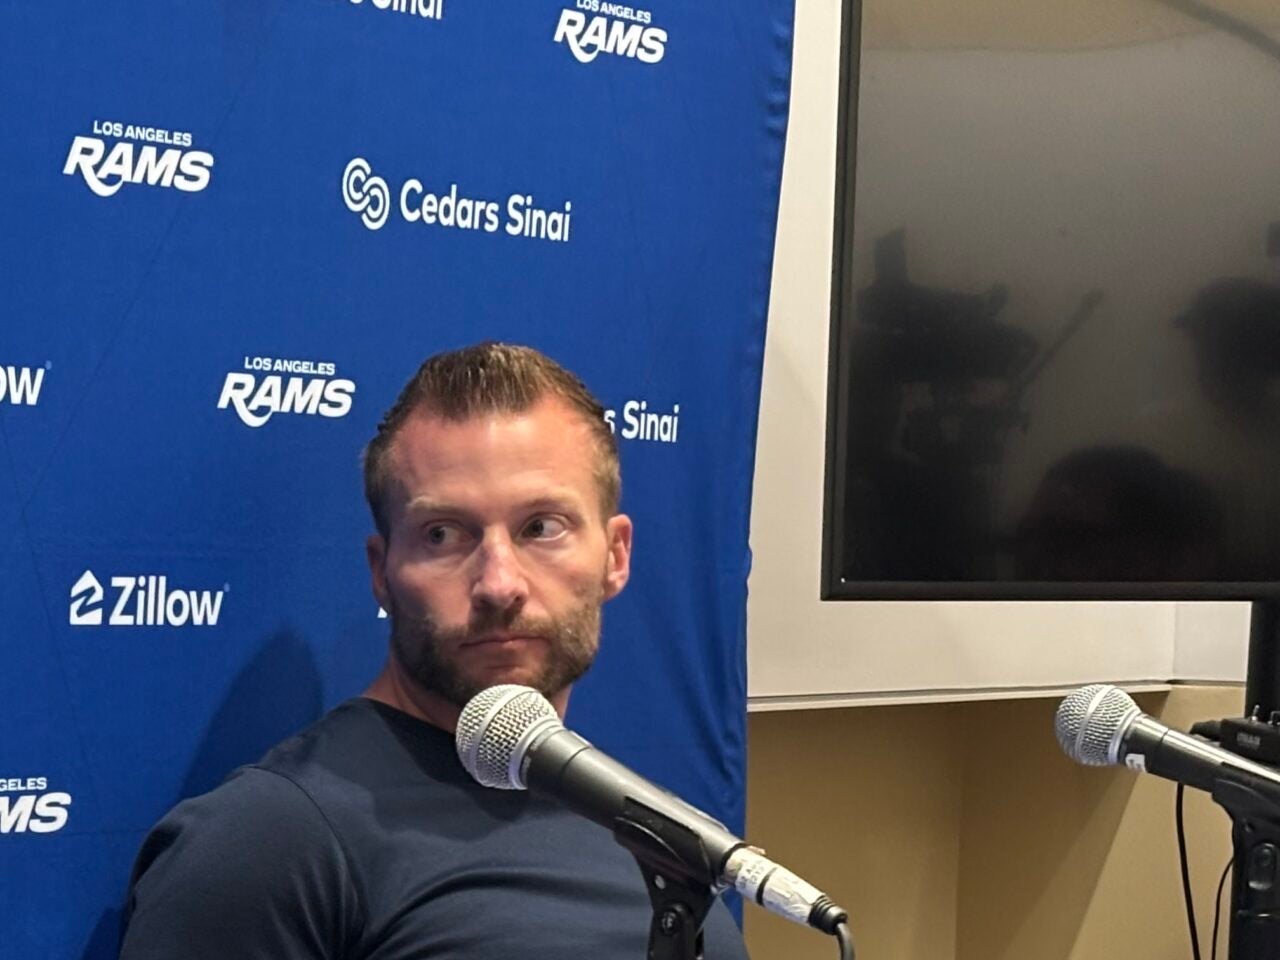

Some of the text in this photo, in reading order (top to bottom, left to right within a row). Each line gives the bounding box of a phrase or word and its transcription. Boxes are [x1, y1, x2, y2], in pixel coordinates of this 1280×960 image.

[553, 8, 668, 64] RAMS
[600, 2, 651, 24] ANGELES
[93, 120, 192, 147] LOS ANGELES
[63, 136, 214, 197] RAMS
[400, 179, 572, 242] Cedars Sinai
[244, 356, 336, 376] LOS ANGELES
[217, 372, 356, 427] RAMS
[621, 400, 680, 443] Sinai
[108, 575, 224, 627] Zillow
